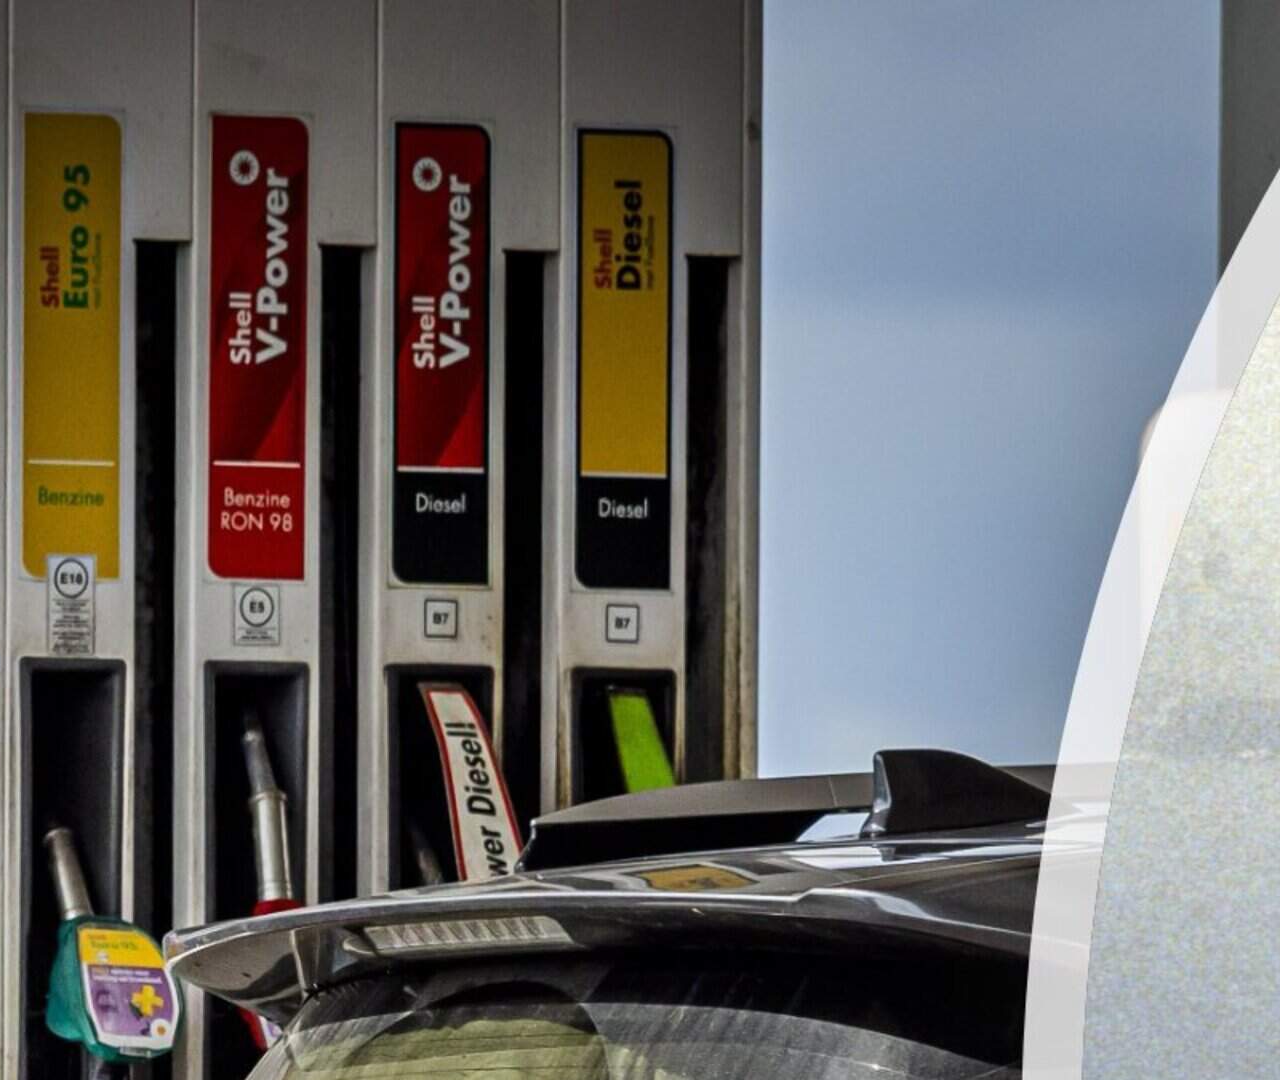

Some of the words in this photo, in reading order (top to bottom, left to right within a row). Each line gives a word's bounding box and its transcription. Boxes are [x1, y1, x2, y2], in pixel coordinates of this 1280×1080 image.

[63, 164, 91, 212] 95
[593, 228, 612, 289] Shell
[615, 179, 642, 290] Diesel
[40, 246, 60, 308] Shell
[63, 225, 89, 309] Euro
[255, 167, 289, 365] V-Power
[439, 174, 470, 369] V-Power
[228, 291, 252, 365] Shell
[412, 296, 435, 369] Shell
[38, 486, 105, 507] Benzine
[221, 512, 264, 531] RON
[270, 513, 293, 532] 98
[224, 487, 290, 509] Benzine
[415, 492, 466, 514] Diesel
[598, 497, 648, 519] Diesel
